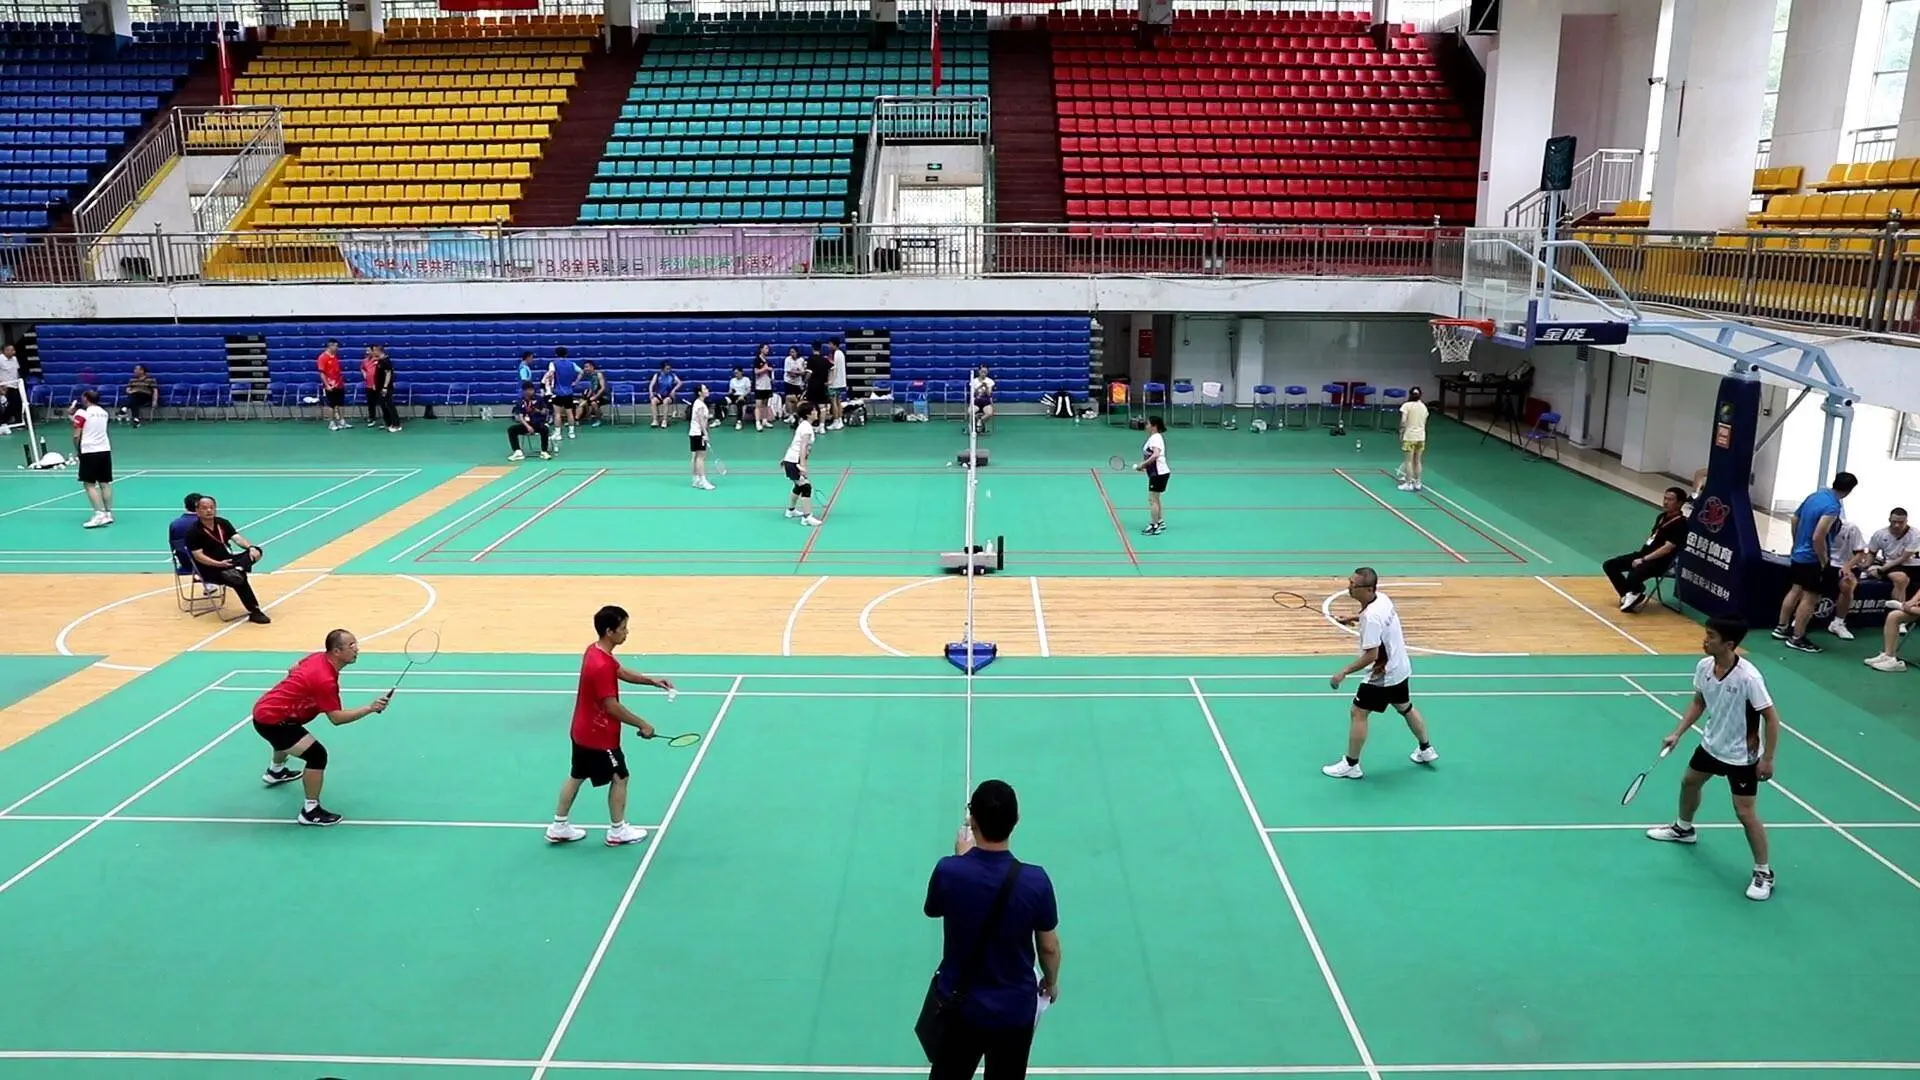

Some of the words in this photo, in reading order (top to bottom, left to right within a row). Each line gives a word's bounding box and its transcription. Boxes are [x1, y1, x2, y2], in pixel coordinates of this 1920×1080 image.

[1542, 327, 1588, 341] 金陵
[1686, 531, 1733, 564] 金陵体育
